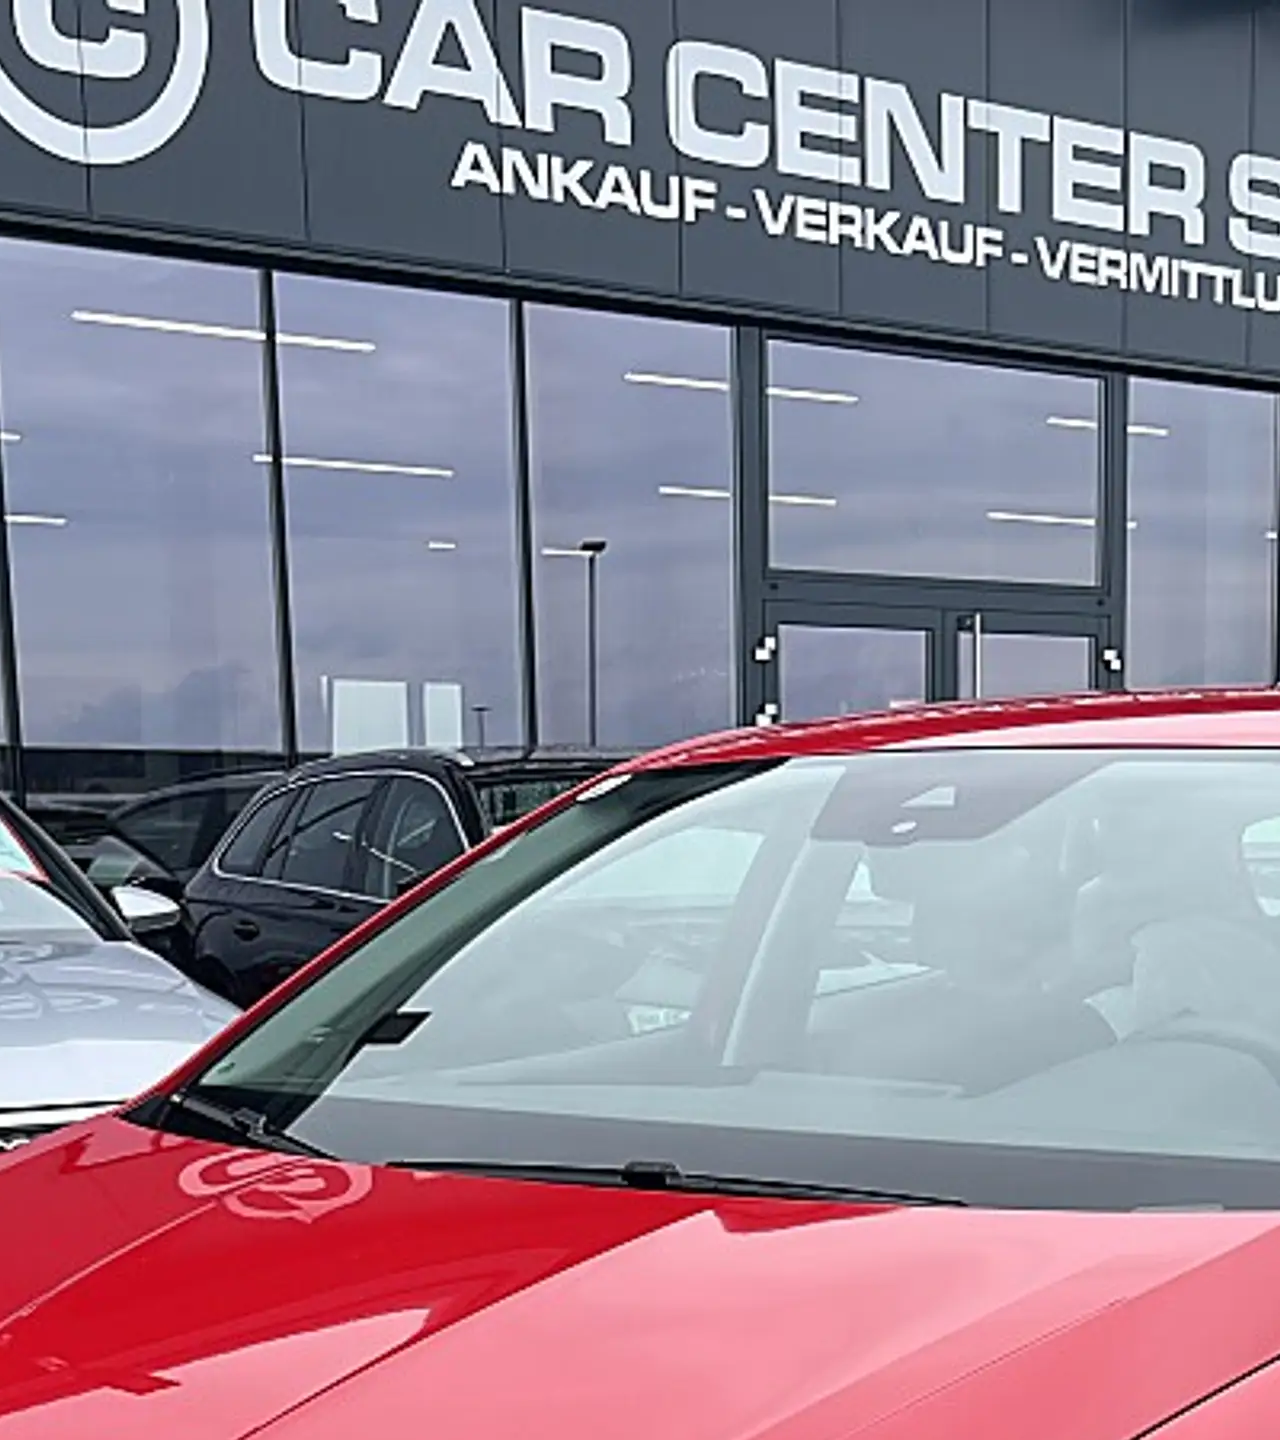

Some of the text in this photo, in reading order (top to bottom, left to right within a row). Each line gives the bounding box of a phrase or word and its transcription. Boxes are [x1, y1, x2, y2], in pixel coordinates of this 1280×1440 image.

[252, 0, 633, 147] CAR
[666, 40, 1206, 246] CENTER
[450, 140, 718, 223] ANKAUF
[752, 187, 1004, 268] VERKAUF
